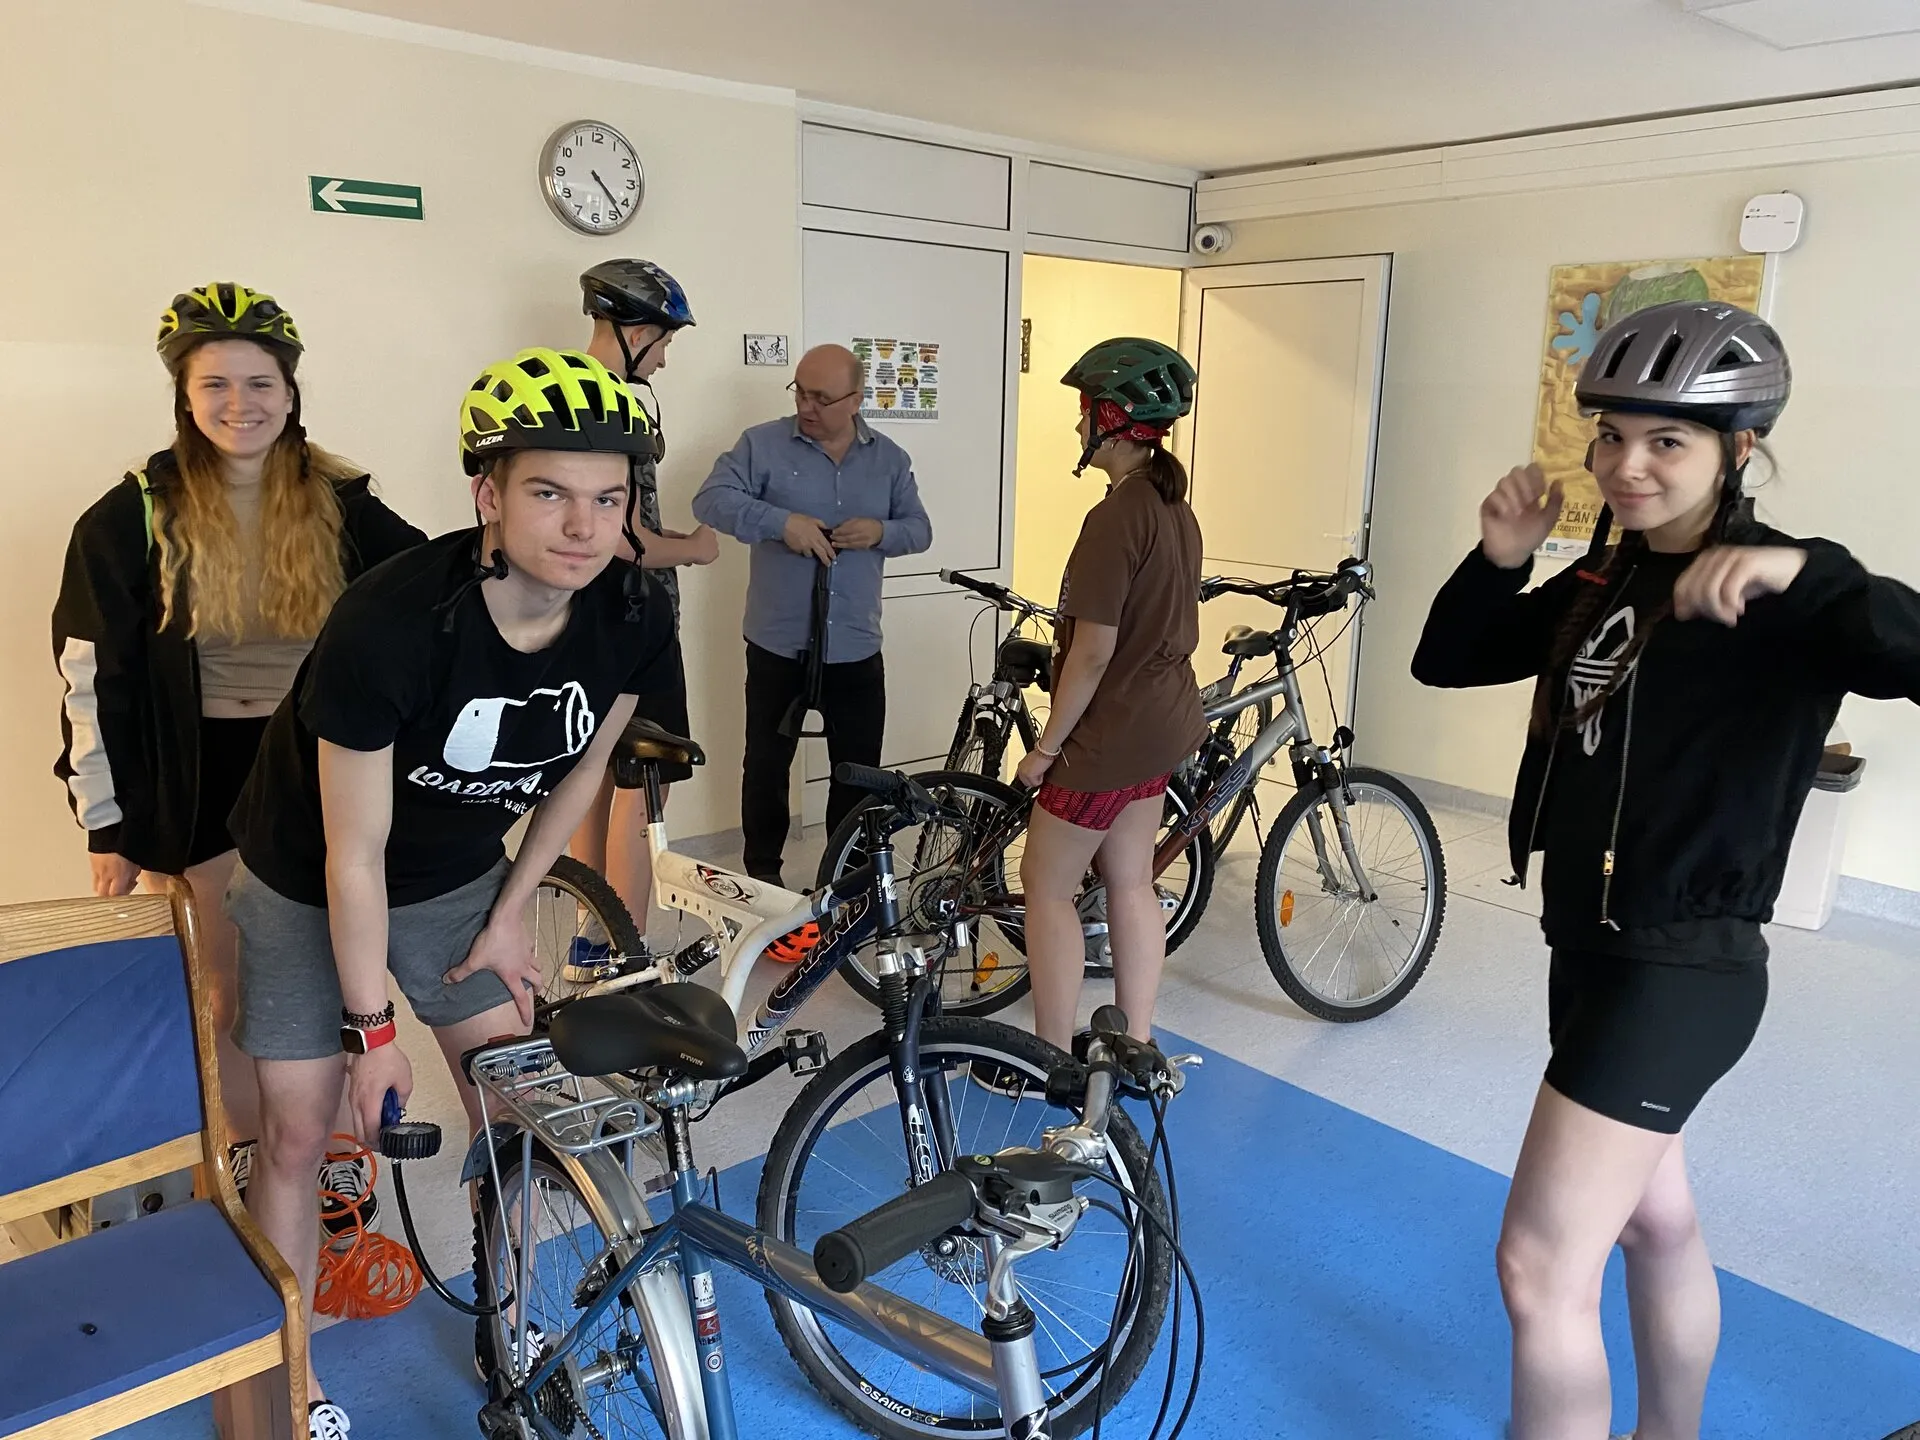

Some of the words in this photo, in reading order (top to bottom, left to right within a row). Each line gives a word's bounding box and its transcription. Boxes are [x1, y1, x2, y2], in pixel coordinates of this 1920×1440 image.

[575, 135, 583, 147] 11
[592, 132, 604, 144] 12
[562, 147, 572, 158] 10
[621, 158, 631, 169] 2
[555, 166, 566, 177] 9
[626, 179, 636, 190] 3
[562, 187, 571, 198] 8
[621, 198, 630, 208] 4
[574, 204, 583, 215] 7
[591, 213, 600, 223] 6
[608, 210, 618, 221] 5
[475, 434, 505, 448] LAZER
[1566, 510, 1590, 524] CAN
[774, 892, 870, 999] GRAND
[869, 1390, 912, 1417] SAIKO
